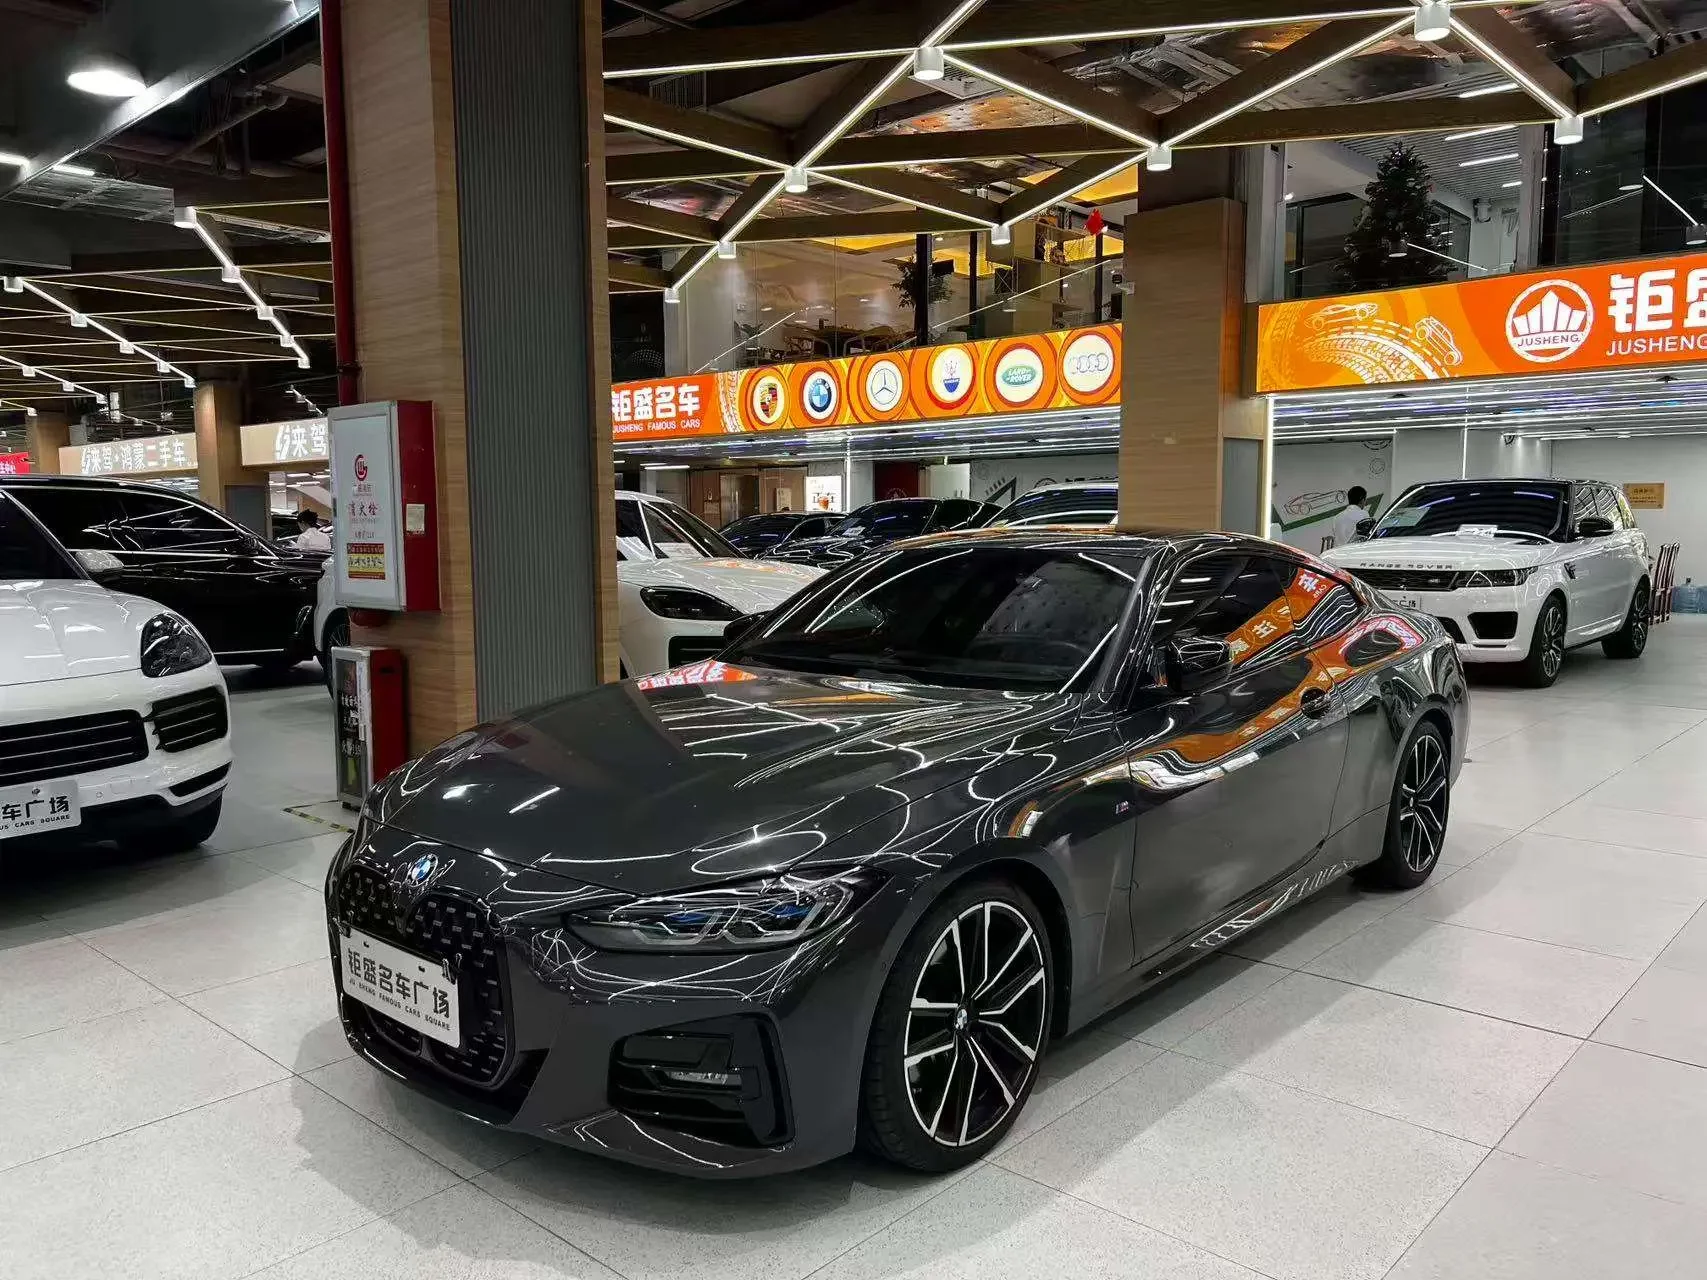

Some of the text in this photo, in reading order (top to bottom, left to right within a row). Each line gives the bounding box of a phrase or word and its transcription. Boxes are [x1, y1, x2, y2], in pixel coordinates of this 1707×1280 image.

[1517, 335, 1580, 347] JUSHENG
[1009, 374, 1032, 383] ROVER
[647, 420, 677, 431] FAMOUS
[680, 418, 701, 429] CARS
[1, 795, 70, 821] 车广场
[15, 820, 35, 828] CARS
[41, 814, 70, 824] SQUARE
[347, 947, 450, 1019] 钜盛名车广场
[358, 982, 376, 997] SHENG
[378, 991, 402, 1009] FAMOUS
[405, 1004, 421, 1018] CARS
[425, 1014, 451, 1031] SQUARE
